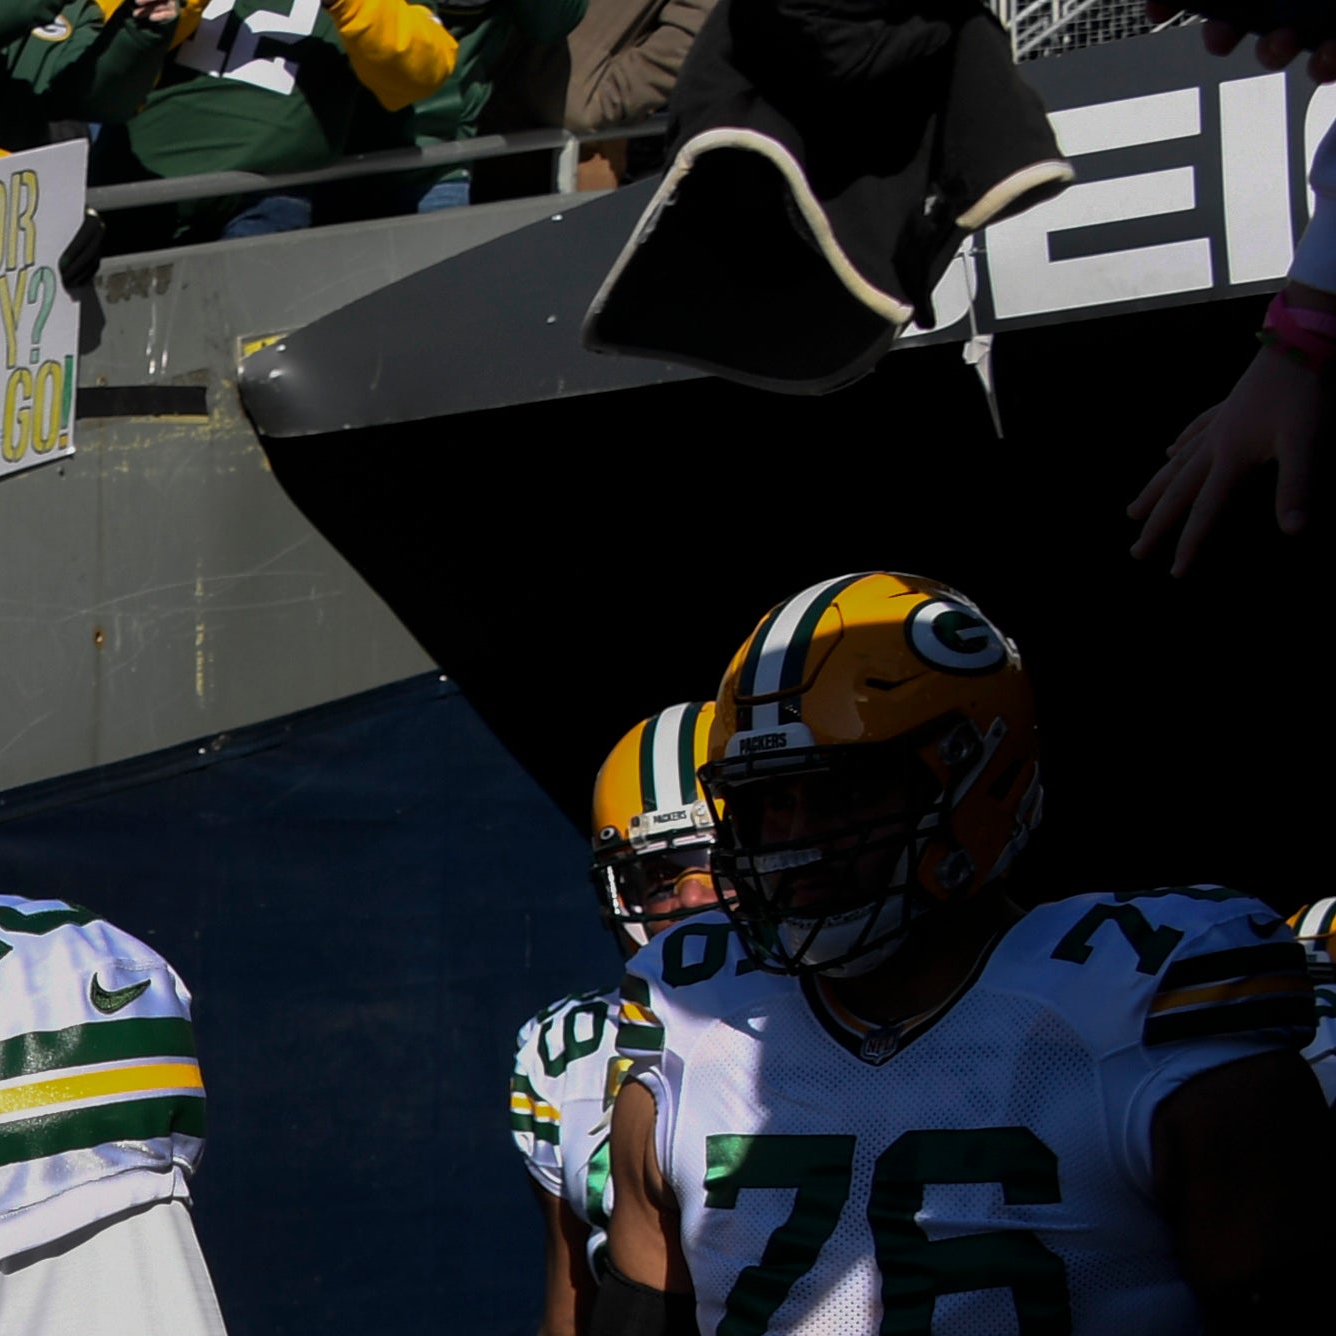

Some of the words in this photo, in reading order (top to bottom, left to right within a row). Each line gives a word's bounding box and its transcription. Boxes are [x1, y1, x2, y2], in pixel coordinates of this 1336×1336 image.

[900, 72, 1336, 341] EI
[2, 354, 75, 463] GO!
[739, 731, 788, 755] PACKERS
[653, 809, 687, 826] PACKERS
